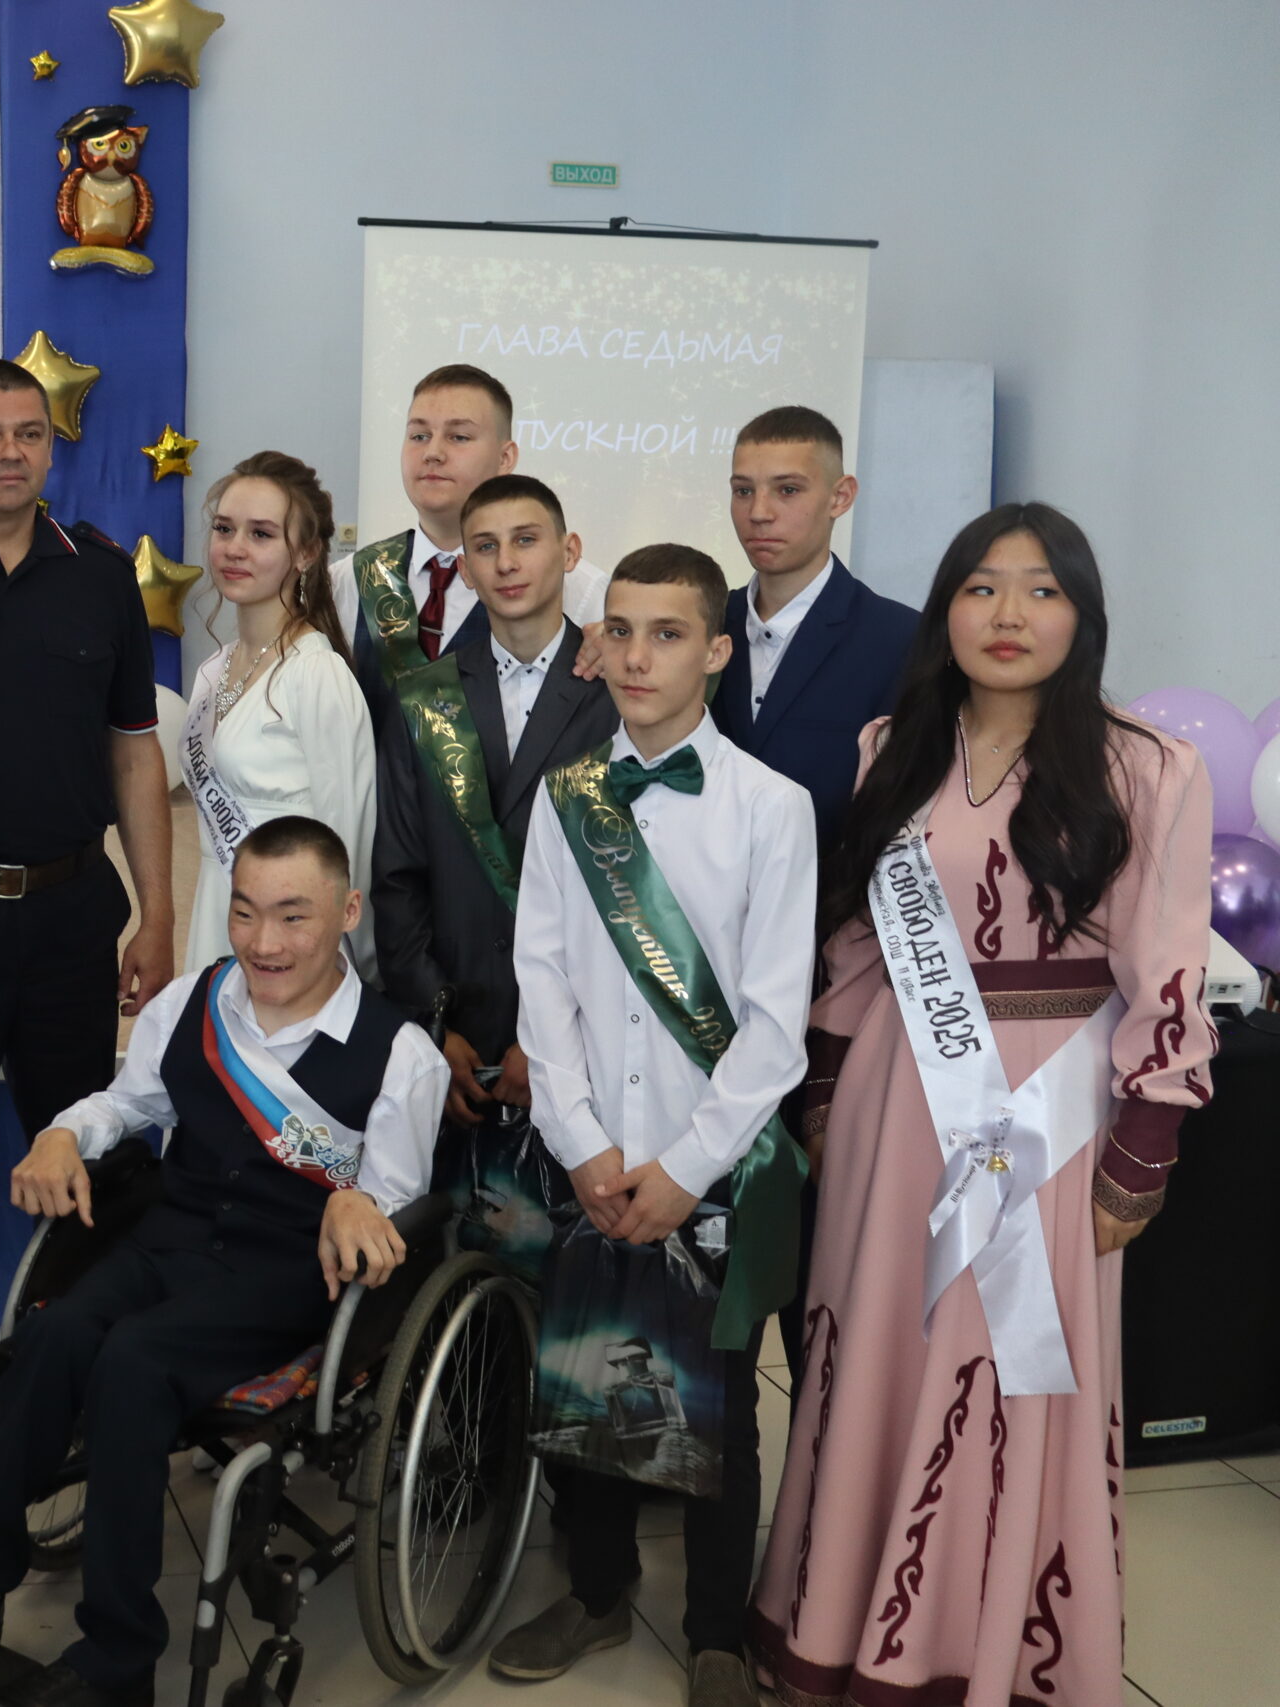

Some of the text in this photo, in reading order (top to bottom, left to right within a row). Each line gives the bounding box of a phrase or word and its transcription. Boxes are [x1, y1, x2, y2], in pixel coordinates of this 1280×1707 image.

[554, 165, 614, 184] ВЫХОД
[457, 323, 784, 368] ГЛАВА СЕДЬМАЯ
[515, 415, 698, 455] ПУСКНОЙ
[186, 732, 209, 791] ДОББИ
[205, 787, 242, 845] СВОБО
[886, 934, 905, 960] СОШ
[922, 990, 982, 1060] 2025
